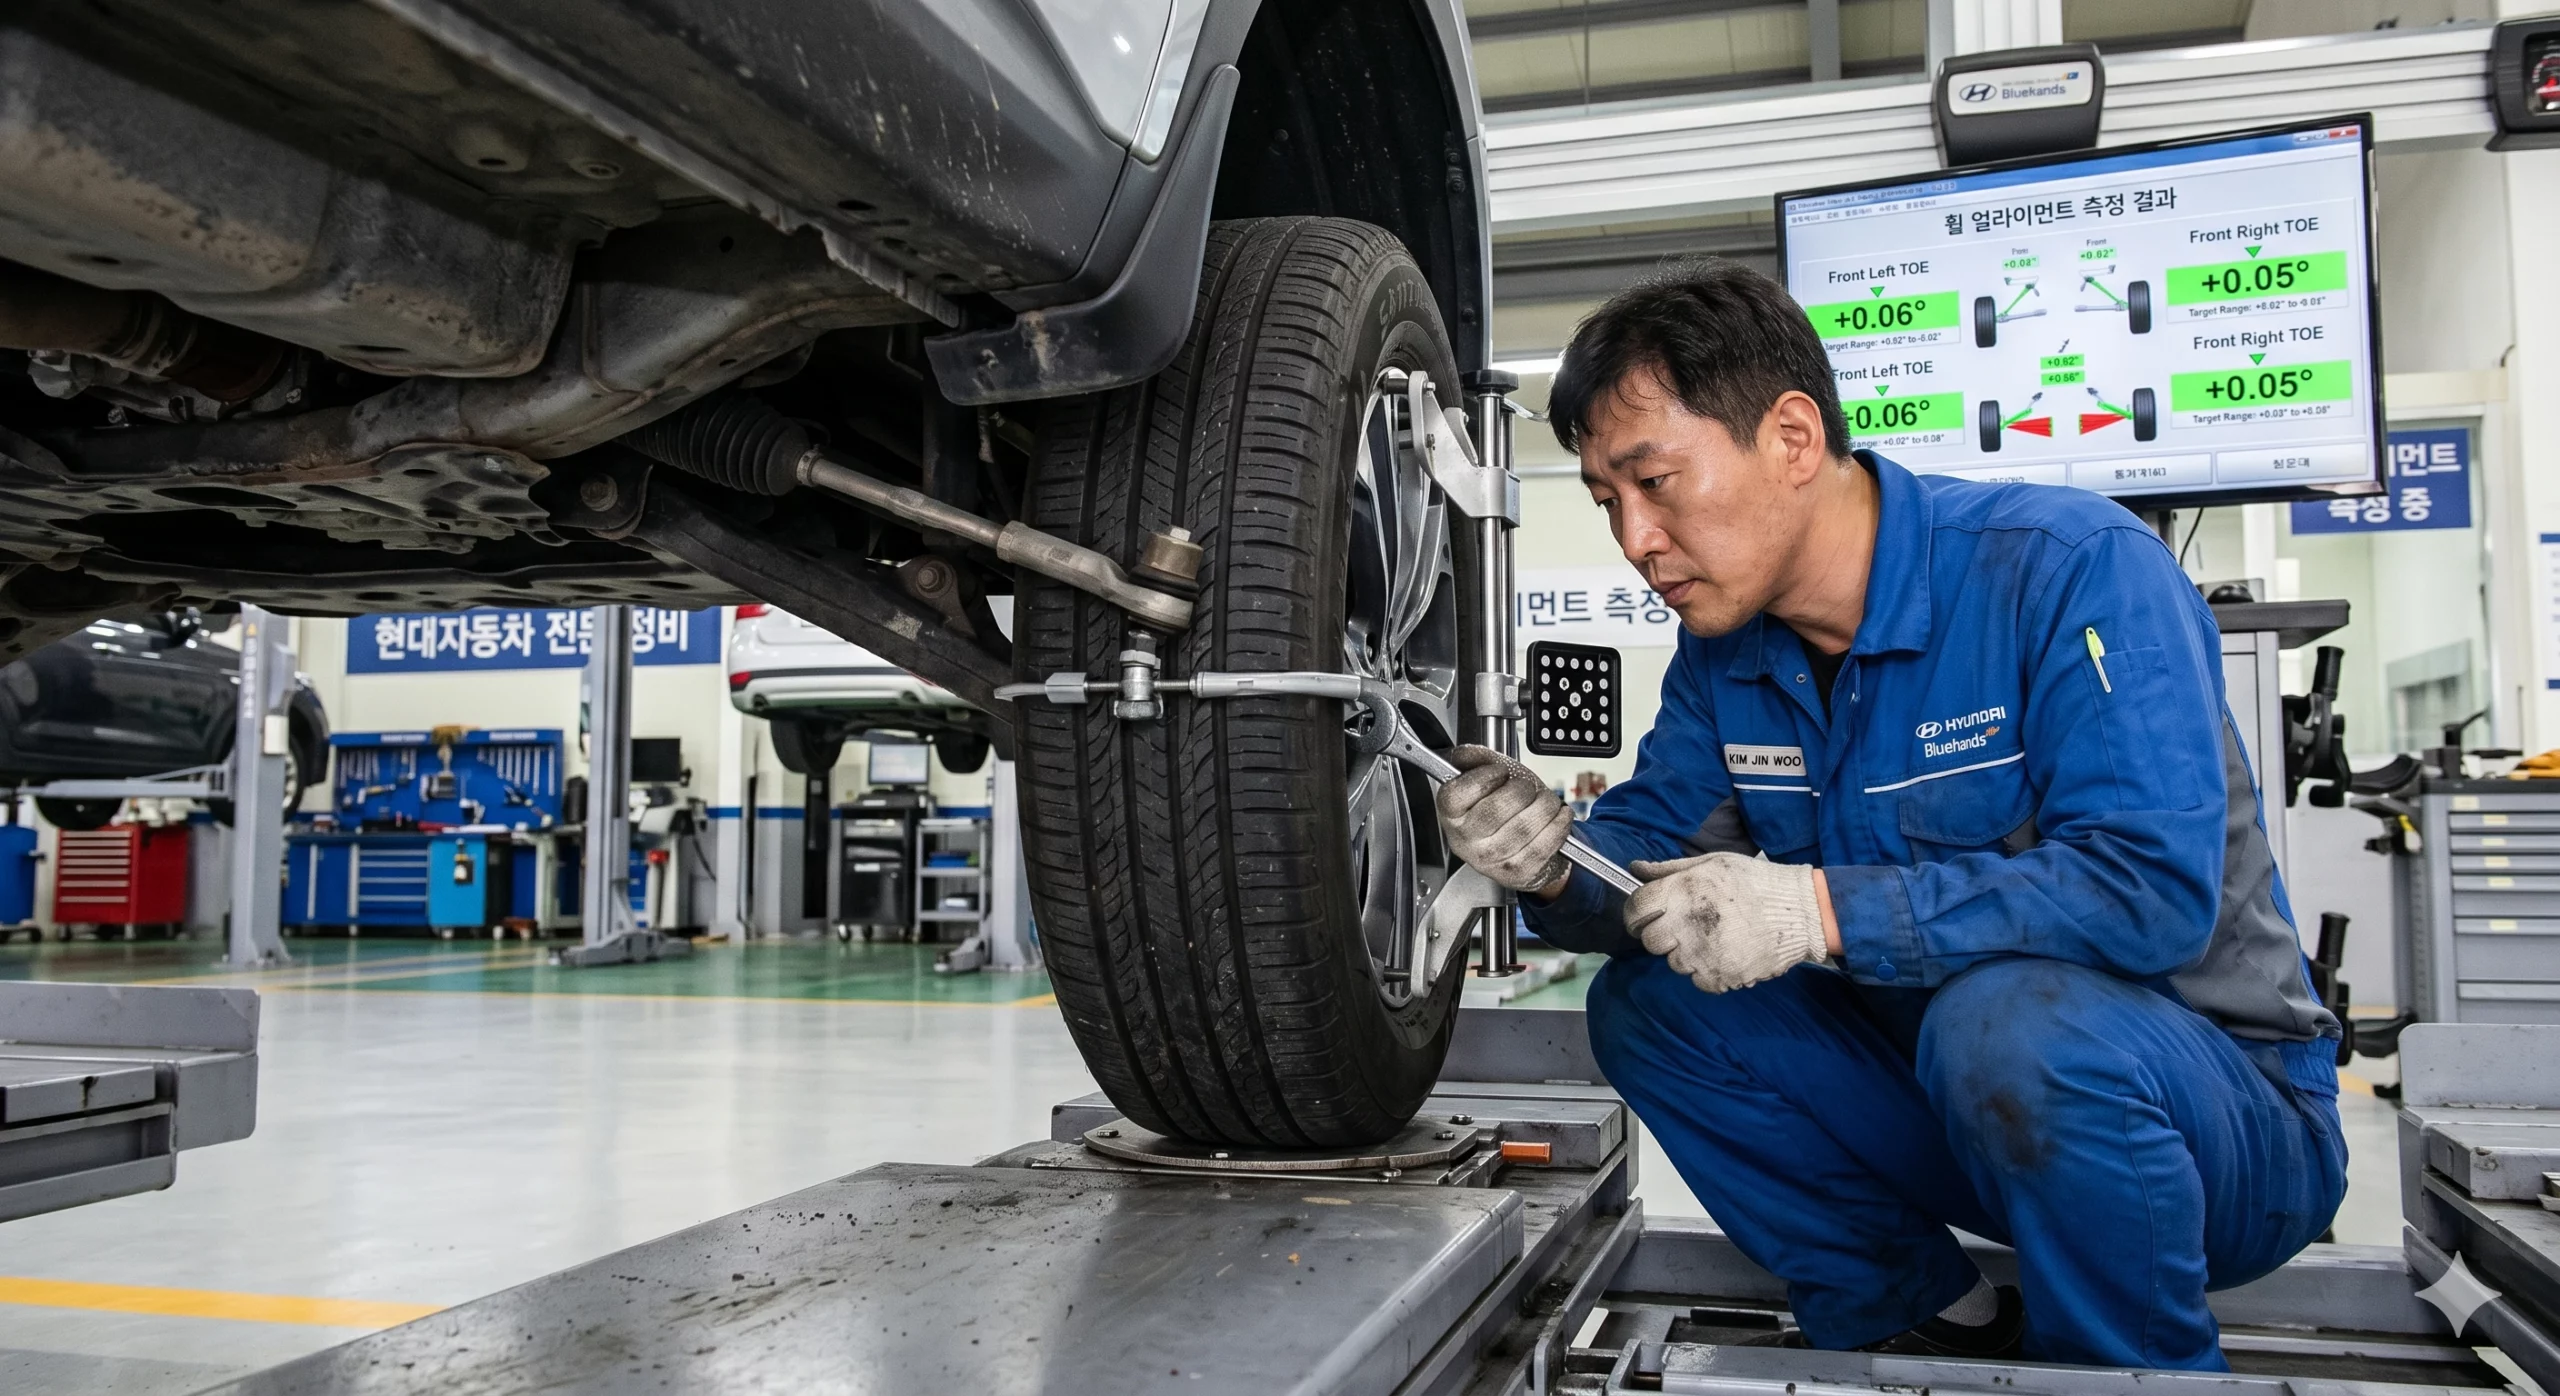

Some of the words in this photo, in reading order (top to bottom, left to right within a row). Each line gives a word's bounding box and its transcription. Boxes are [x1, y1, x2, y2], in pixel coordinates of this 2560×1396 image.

[1944, 213, 1963, 236] 휠
[1971, 200, 2076, 233] 얼라이먼트
[2082, 193, 2125, 218] 측정
[2133, 187, 2177, 213] 결과
[2190, 227, 2232, 243] Front
[2237, 222, 2279, 241] Right
[2284, 217, 2319, 233] TOE
[1828, 268, 1865, 284] Front
[1869, 265, 1896, 279] Left
[1900, 261, 1929, 275] TOE
[2201, 260, 2309, 294] +0.05°
[1834, 300, 1926, 330] +0.06°
[2189, 305, 2217, 318] Target
[2219, 303, 2252, 316] Range:
[1850, 339, 1878, 350] Range:
[2193, 334, 2236, 350] Front
[2241, 330, 2284, 348] Right
[2289, 325, 2324, 342] TOE
[1872, 364, 1899, 378] Left
[1903, 360, 1933, 375] TOE
[2205, 369, 2312, 401] +0.05°
[2193, 413, 2221, 425] Target
[2399, 487, 2432, 522] 중
[1604, 587, 1670, 624] 측정
[374, 611, 535, 660] 현대자동차
[1945, 706, 2006, 732] HYUNDAI
[1924, 732, 1987, 758] Bluehands
[1729, 753, 1748, 765] KIM
[1751, 755, 1769, 766] JIN
[1773, 756, 1802, 767] WOO
